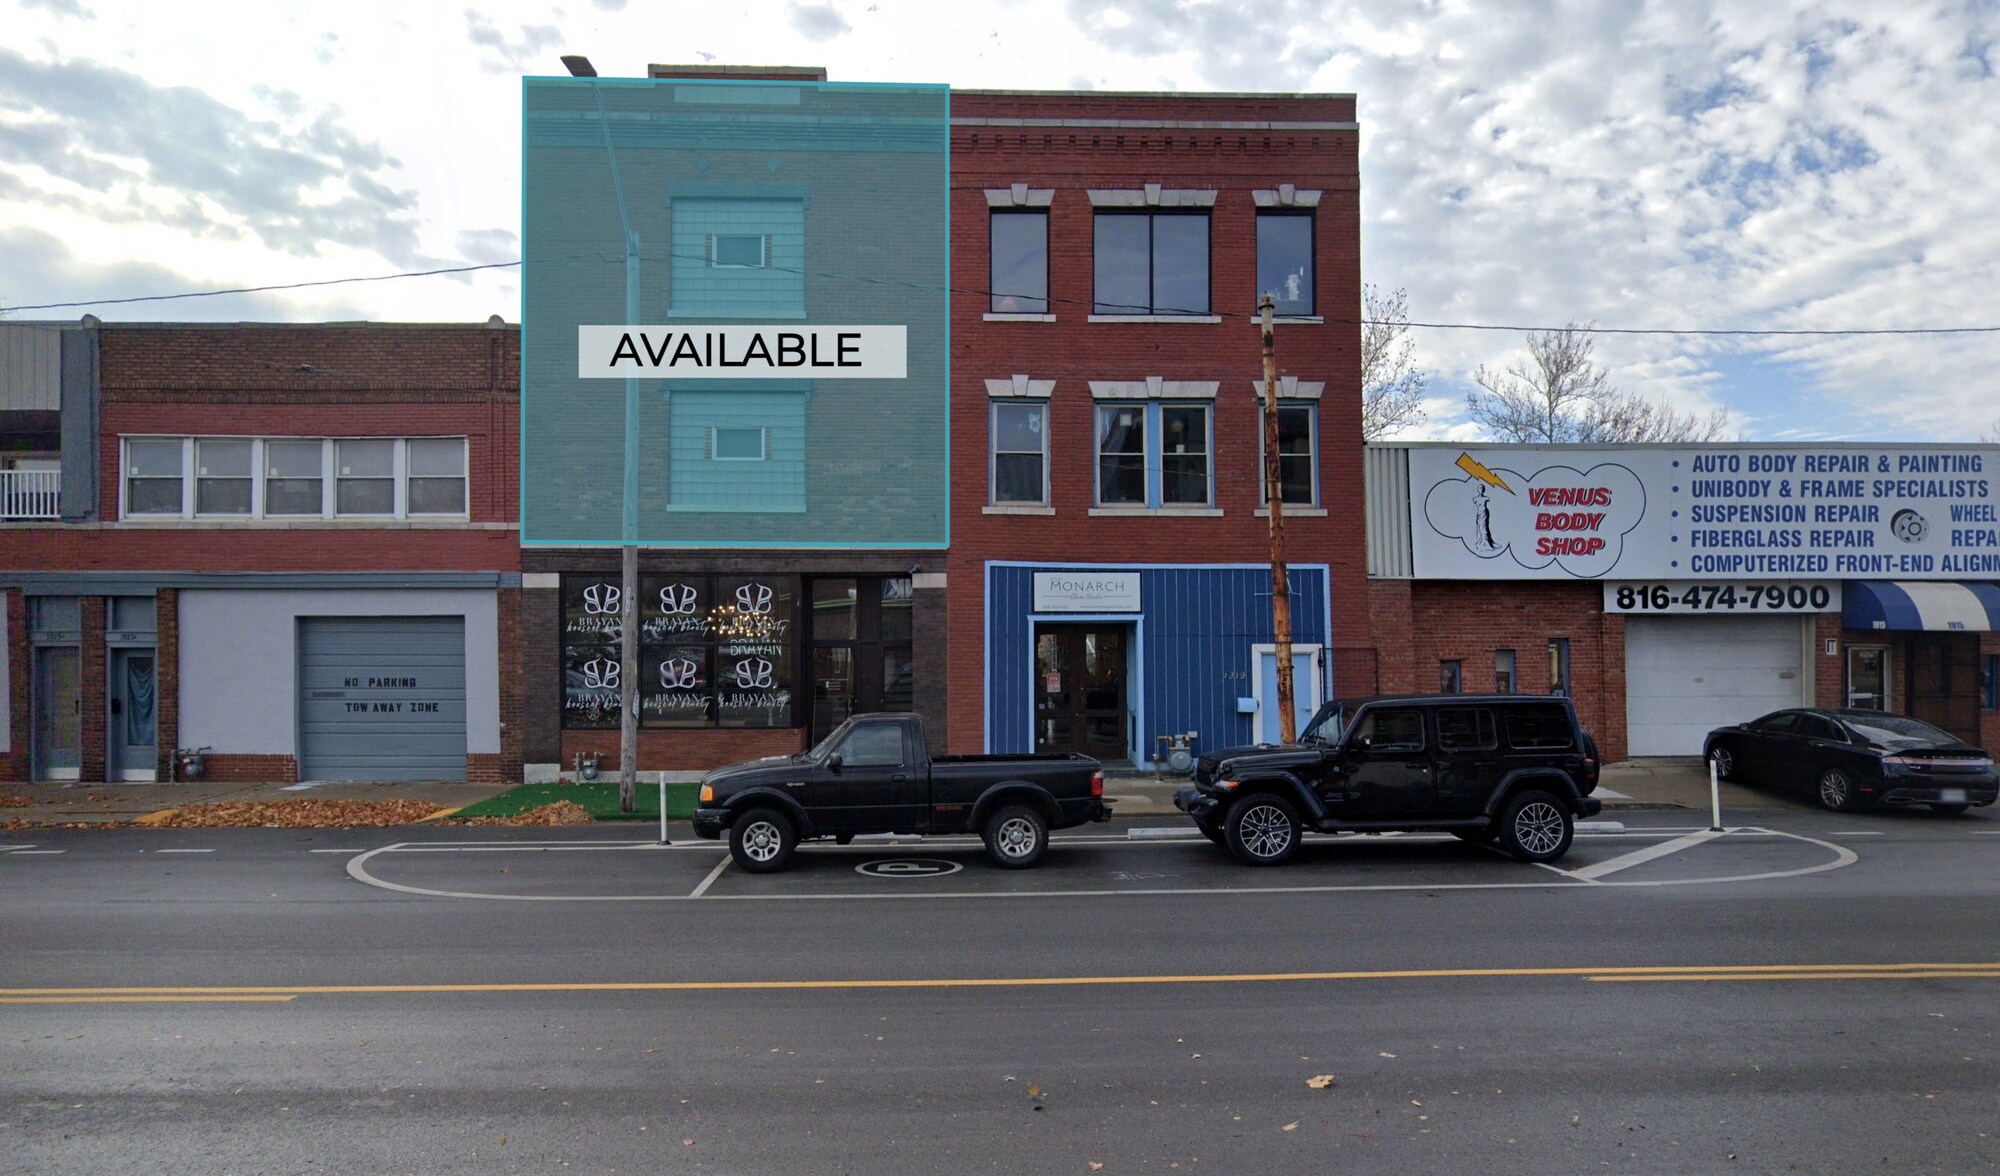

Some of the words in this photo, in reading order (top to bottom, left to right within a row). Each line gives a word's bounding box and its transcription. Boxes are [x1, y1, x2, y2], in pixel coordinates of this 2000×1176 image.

[1692, 455, 1740, 473] AUTO
[1748, 455, 1797, 473] BODY
[1804, 455, 1869, 473] REPAIR
[1877, 455, 1890, 473] &
[1899, 455, 1982, 473] PAINTING
[1528, 487, 1612, 506] VENUS
[1692, 480, 1771, 498] UNIBODY
[1779, 479, 1792, 498] &
[1800, 480, 1865, 498] FRAME
[1872, 480, 1988, 498] SPECIALISTS
[1535, 512, 1606, 531] BODY
[1691, 504, 1806, 523] SUSPENSION
[1814, 505, 1879, 522] REPAIR
[1950, 504, 1997, 522] WHEEL
[1535, 537, 1605, 556] SHOP
[1691, 530, 1802, 548] FIBERGLASS
[1810, 530, 1874, 547] REPAIR
[1691, 555, 1828, 573] COMPUTERIZED
[1836, 555, 1933, 572] FRONT-END
[1050, 581, 1124, 592] MONARCH
[1616, 585, 1830, 610] 816-474-7900
[655, 617, 702, 626] BRAYAN
[1872, 620, 1887, 629] 1915
[1947, 622, 1964, 630] 1915
[344, 677, 359, 687] NO
[368, 677, 417, 687] PARKING
[655, 693, 702, 702] BRAYAN
[731, 693, 775, 702] BRAYAN
[345, 702, 368, 712] TOW
[372, 702, 402, 712] AWAY
[410, 702, 439, 712] ZONE
[1325, 791, 1343, 799] Jeep
